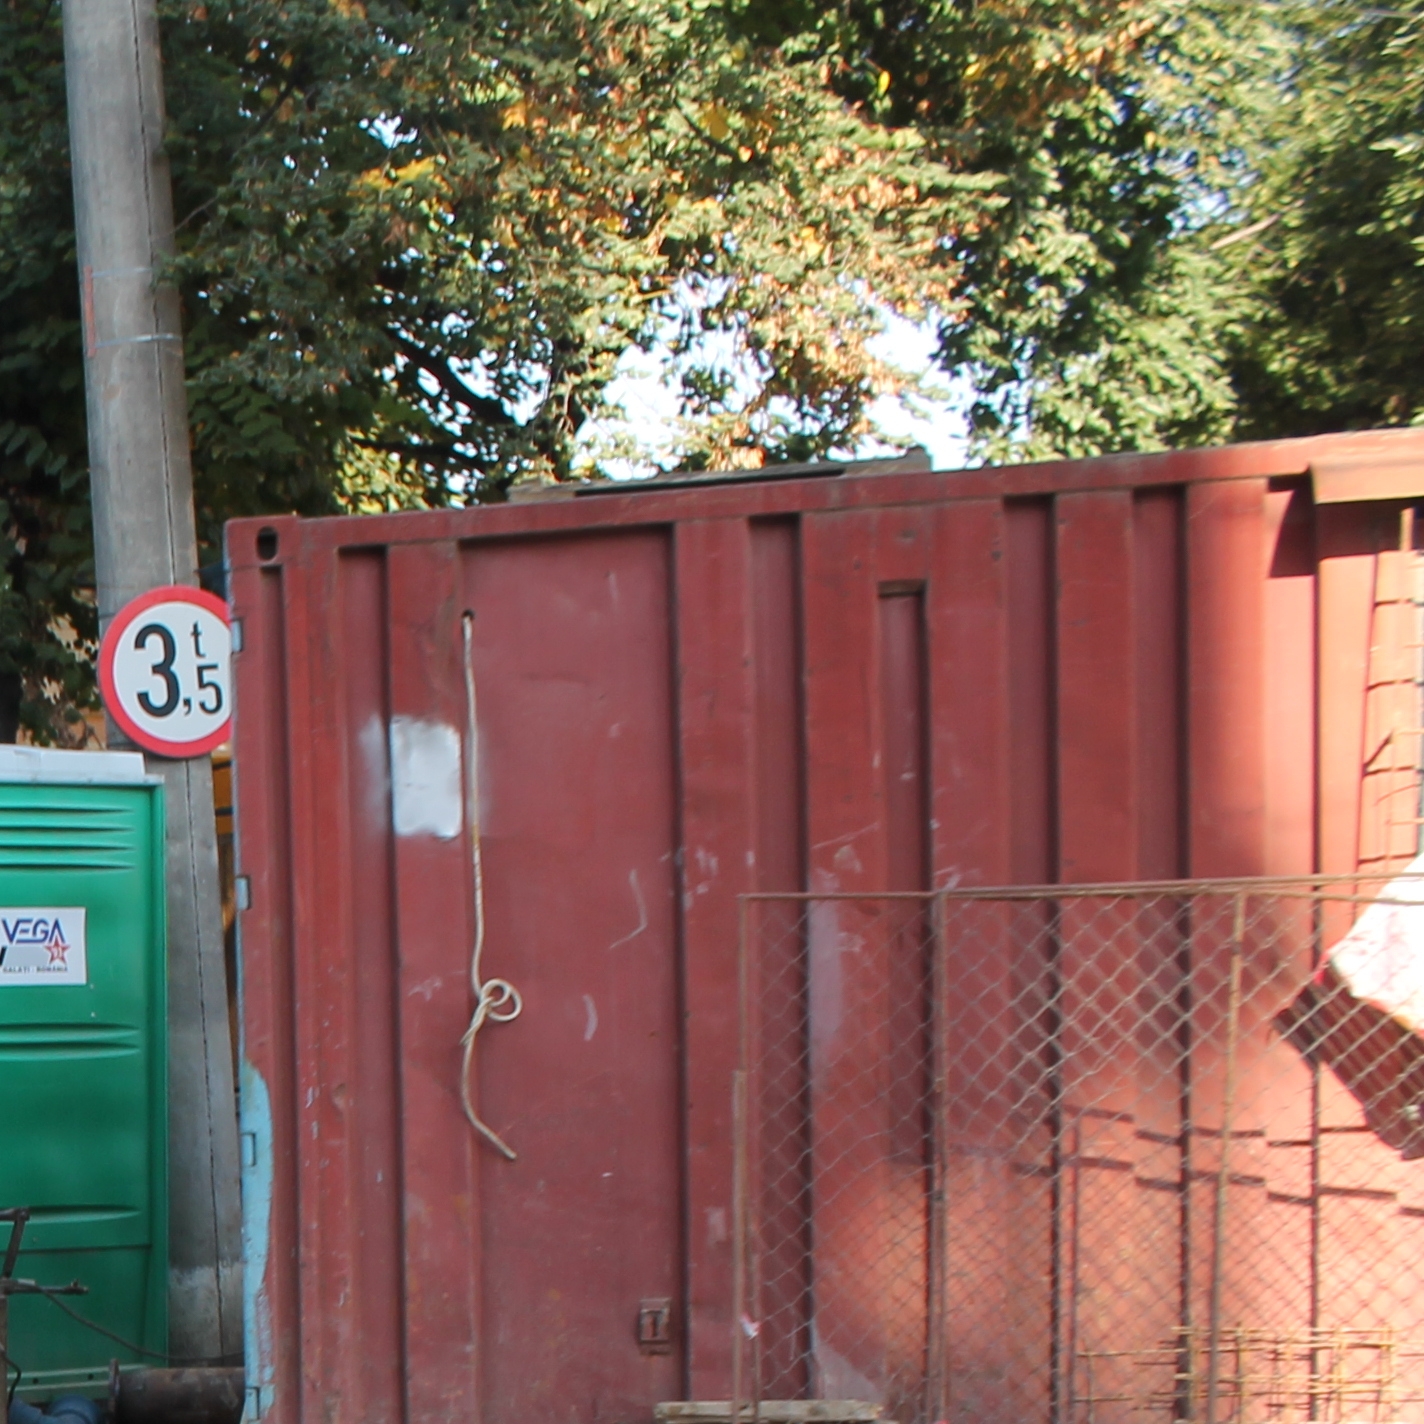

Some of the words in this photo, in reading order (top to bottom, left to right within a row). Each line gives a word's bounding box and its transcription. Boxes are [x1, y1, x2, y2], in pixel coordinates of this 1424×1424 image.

[190, 620, 207, 659] t
[133, 622, 224, 718] 3,5
[1, 918, 66, 944] VEGA
